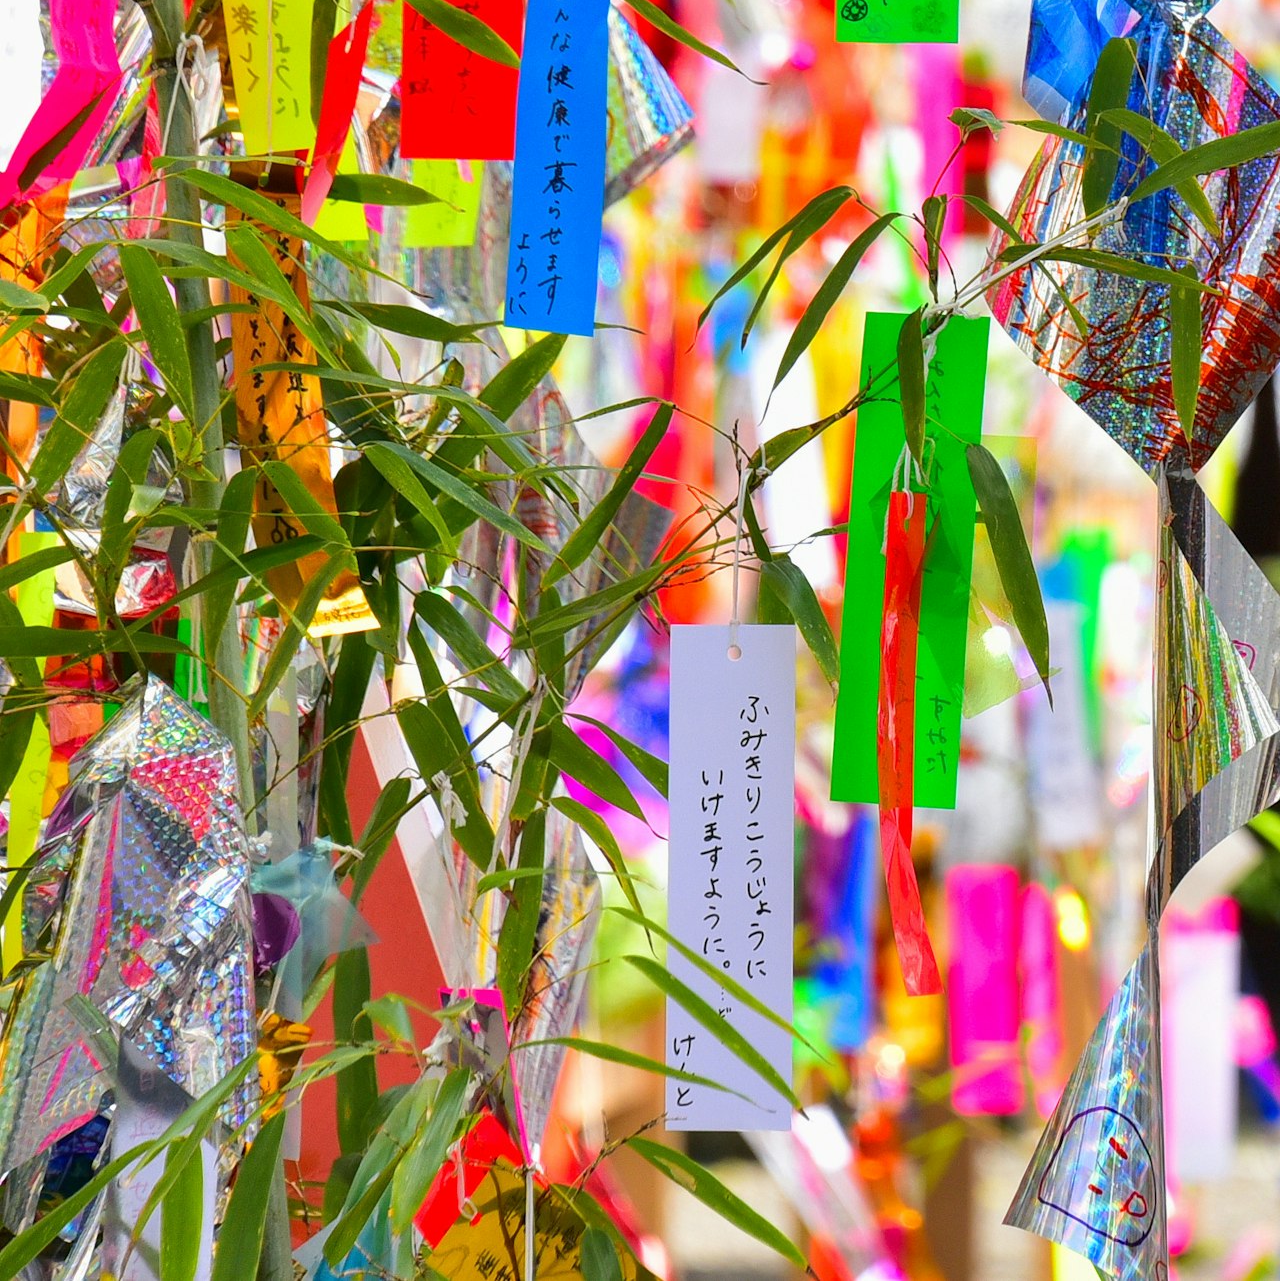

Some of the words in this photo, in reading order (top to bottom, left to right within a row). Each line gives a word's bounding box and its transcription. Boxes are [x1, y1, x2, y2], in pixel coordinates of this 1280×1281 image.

[508, 231, 534, 316] ように
[738, 695, 773, 980] ふみきりこうじょうに
